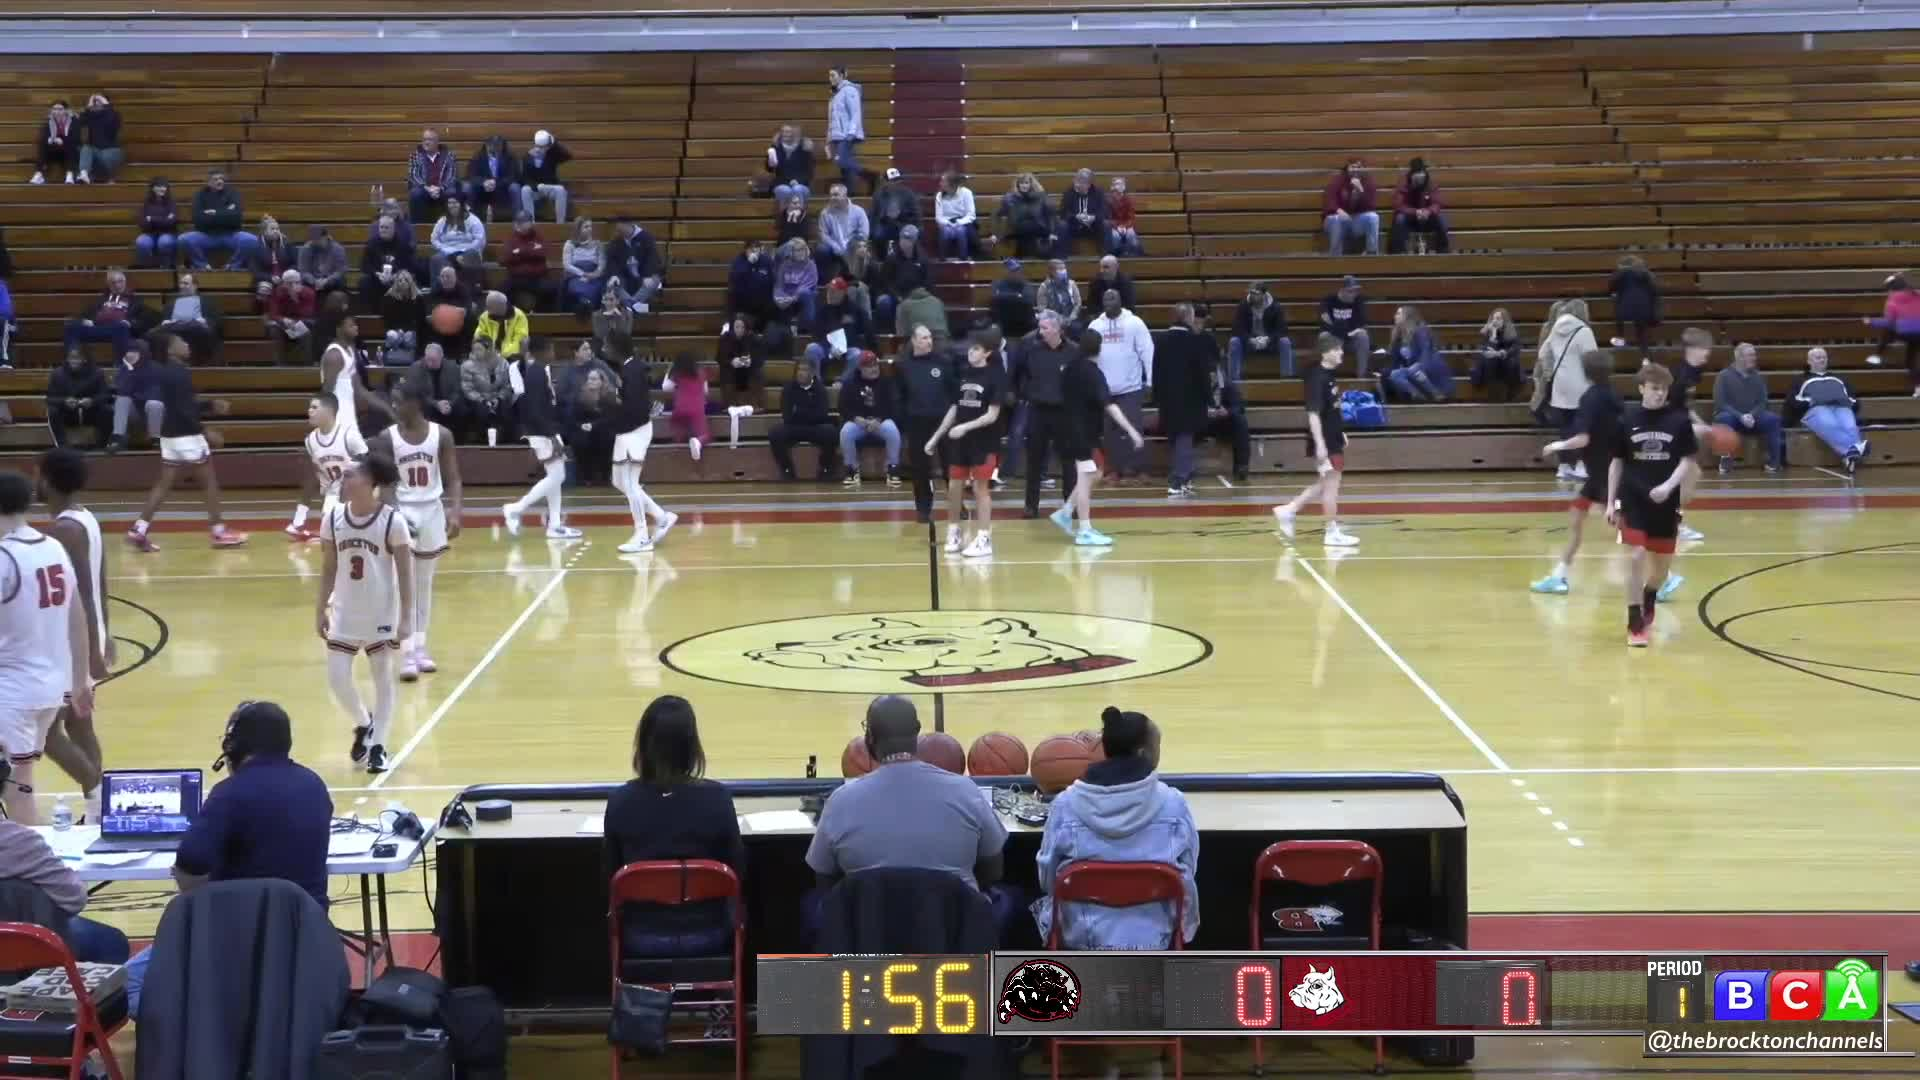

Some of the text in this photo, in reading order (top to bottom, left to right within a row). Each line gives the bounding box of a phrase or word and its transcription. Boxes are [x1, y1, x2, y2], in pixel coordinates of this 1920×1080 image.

[408, 466, 429, 488] 10
[350, 555, 364, 580] 3
[35, 564, 66, 609] 15
